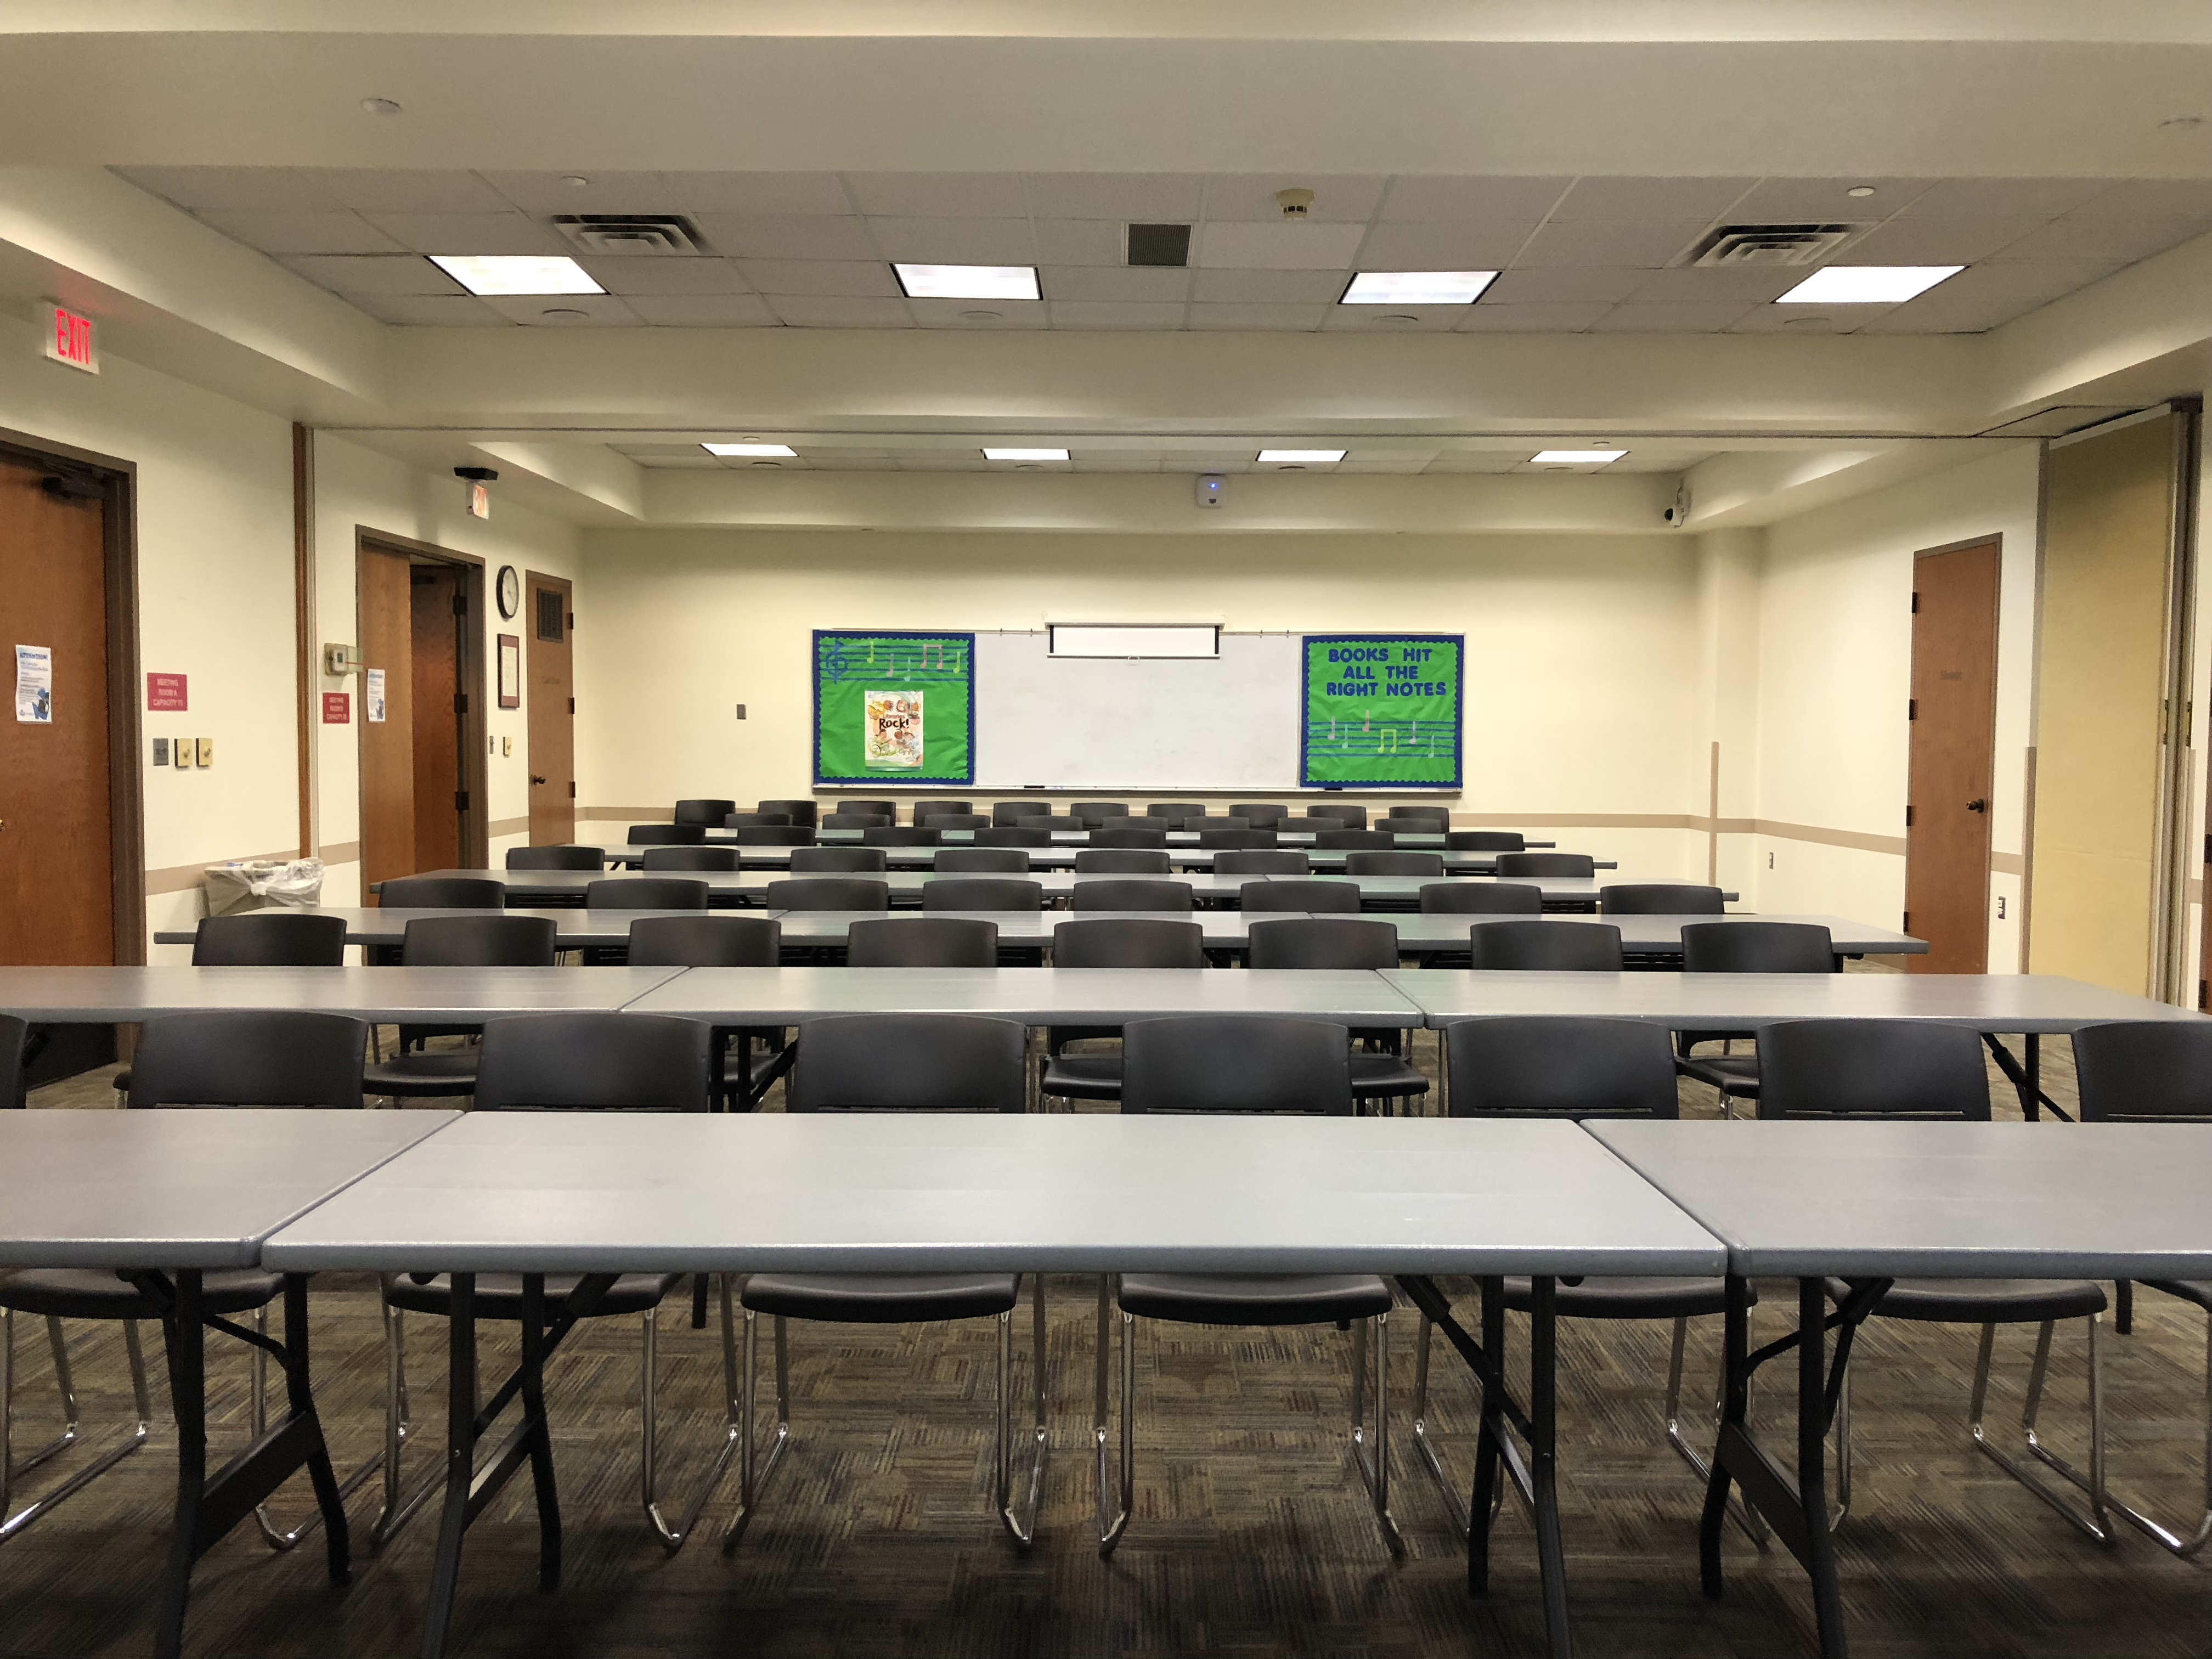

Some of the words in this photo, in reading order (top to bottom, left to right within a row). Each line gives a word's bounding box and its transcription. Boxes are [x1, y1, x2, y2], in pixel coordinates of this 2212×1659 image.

[57, 308, 90, 365] EXIT
[1328, 648, 1389, 663] BOOKS
[1403, 648, 1432, 662] HIT
[1343, 665, 1375, 679] ALL
[1385, 665, 1418, 679] THE
[1327, 682, 1379, 696] RIGHT
[1386, 682, 1446, 697] NOTES
[879, 719, 909, 730] Rock!
